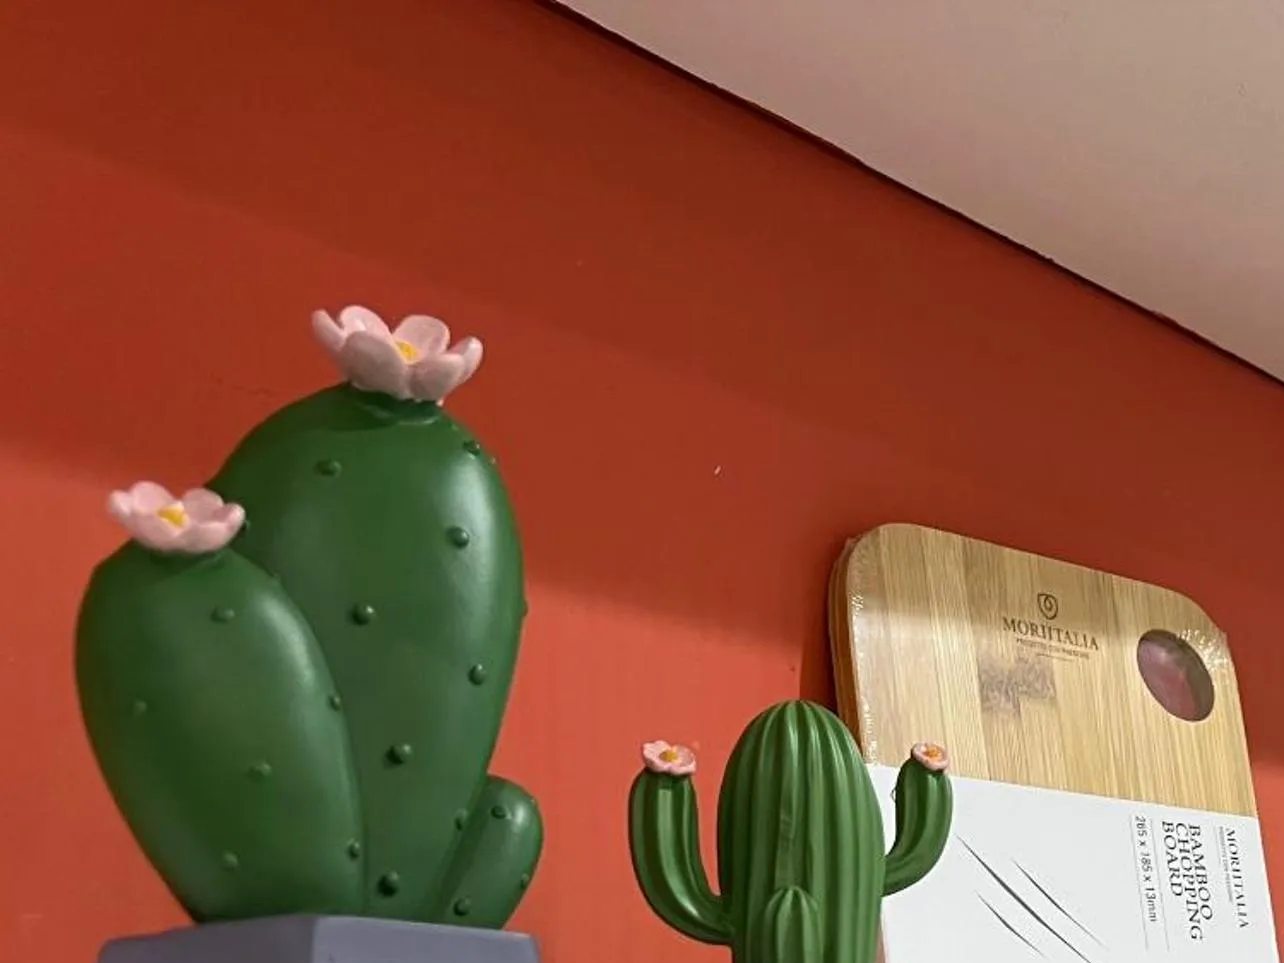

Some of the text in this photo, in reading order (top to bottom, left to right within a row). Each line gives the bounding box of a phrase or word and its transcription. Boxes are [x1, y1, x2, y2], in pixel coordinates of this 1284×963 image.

[1003, 616, 1099, 651] MORIITALIA
[1162, 821, 1183, 896] BOARD
[1175, 822, 1203, 940] CHOPPING
[1188, 824, 1213, 920] BAMBOO
[1226, 828, 1249, 928] MORIITALIA
[1146, 887, 1157, 922] 13mm
